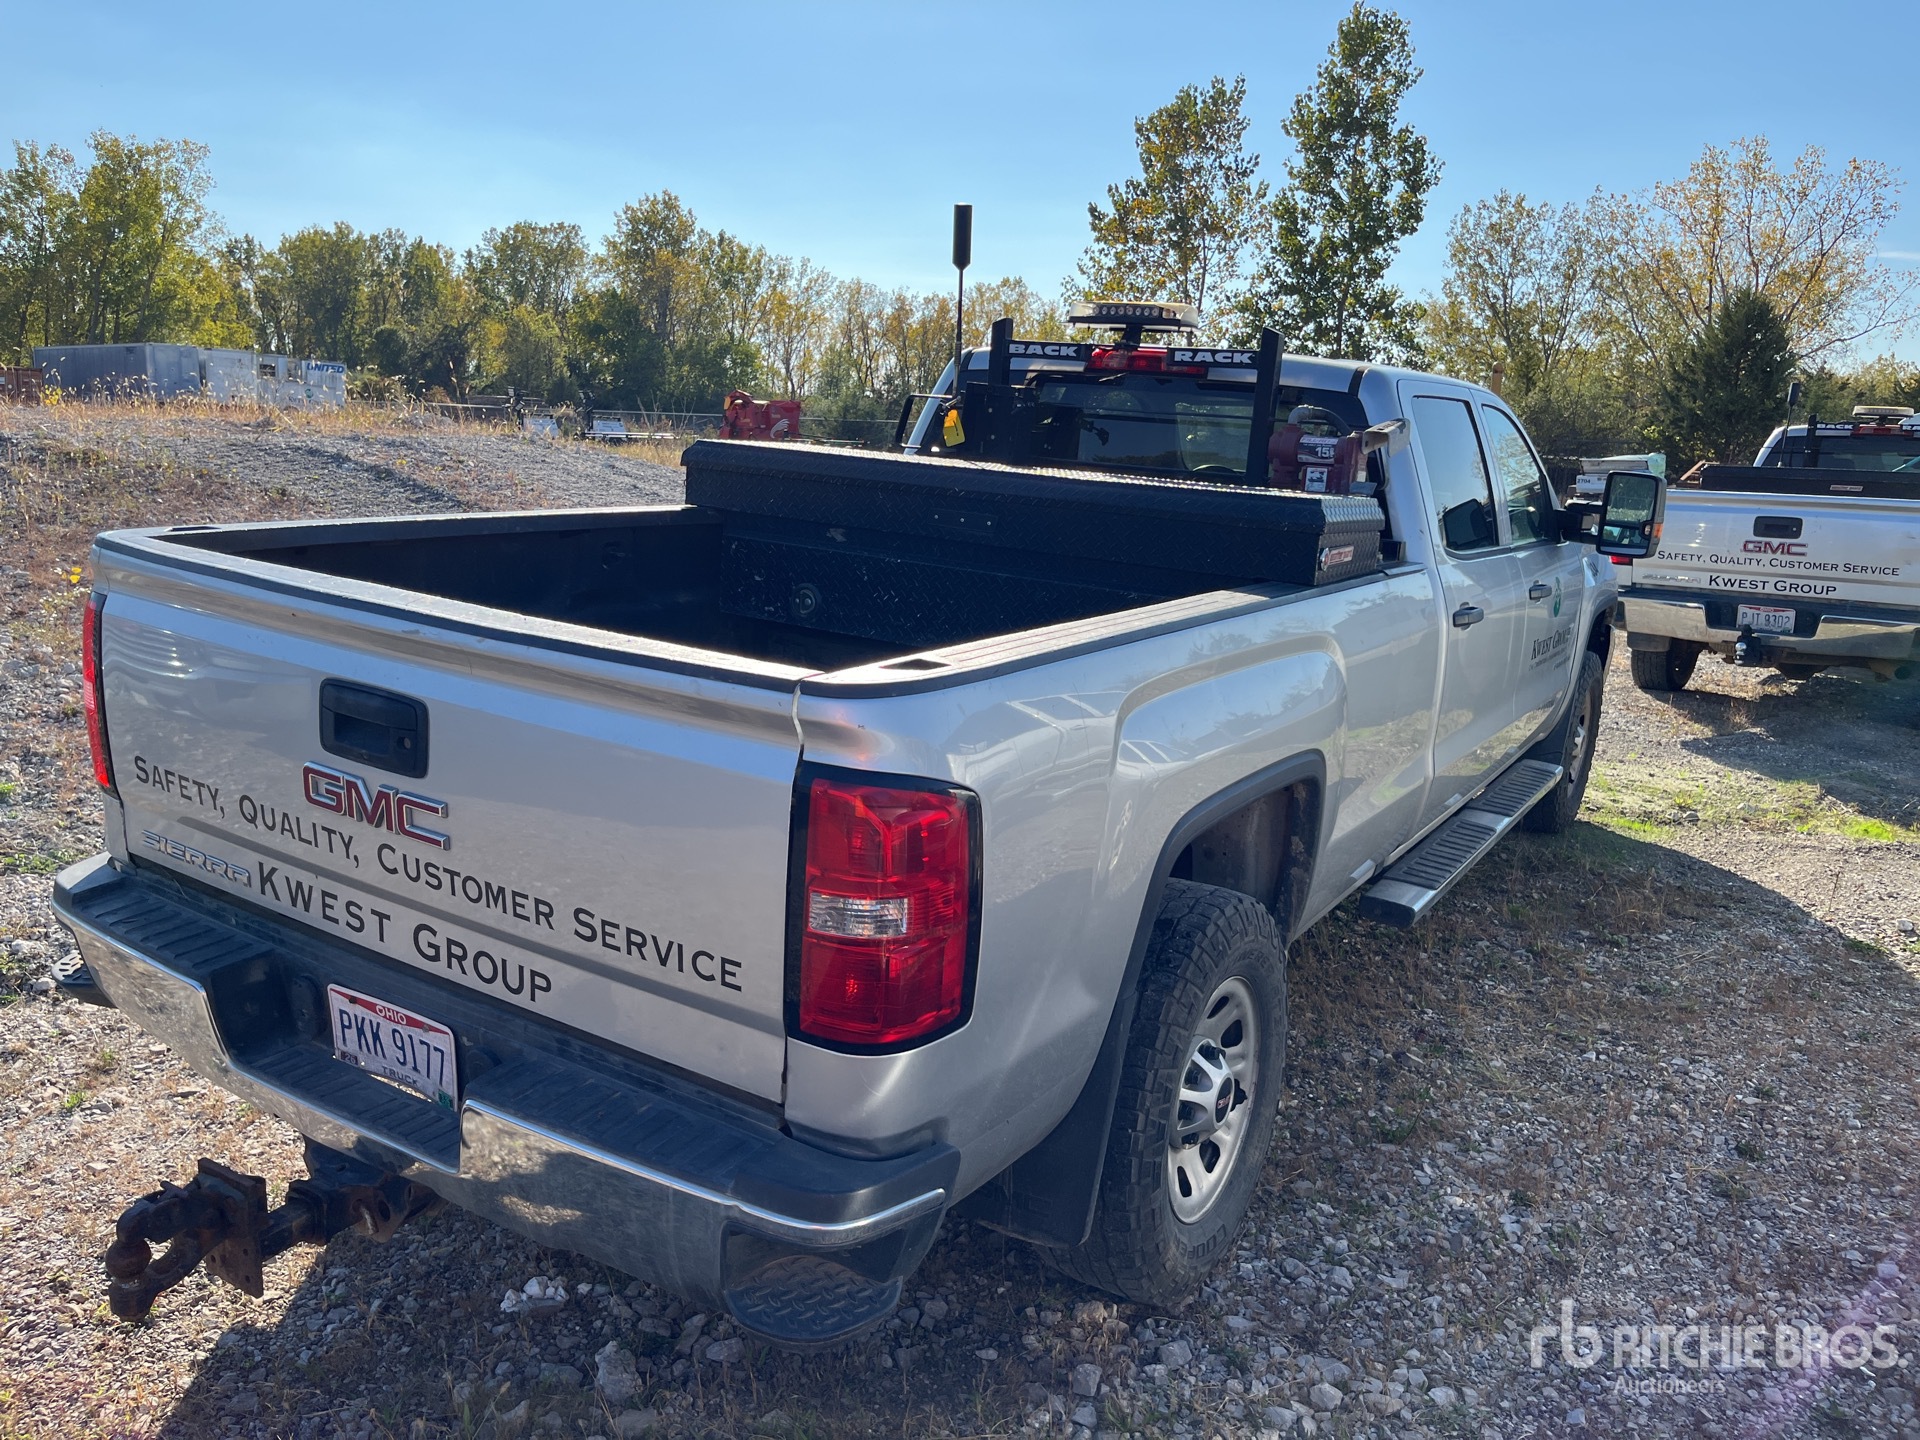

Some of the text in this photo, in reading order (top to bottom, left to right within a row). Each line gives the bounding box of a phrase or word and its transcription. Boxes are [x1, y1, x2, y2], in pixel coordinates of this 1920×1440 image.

[1008, 343, 1253, 364] BACK RACK
[307, 363, 345, 373] UNITED
[1743, 540, 1808, 556] GMC
[1657, 550, 1900, 576] SAFETY, QUALITY, CUSTOMER SERVICE
[1708, 575, 1838, 596] KWEST GROUP
[302, 760, 451, 851] GMC
[141, 829, 252, 889] SIERRA
[134, 755, 743, 993] SAFETY, QUALITY, CUSTOMER SERVICE
[258, 860, 553, 1002] KWEST GROUP
[375, 1004, 407, 1025] OHIO
[338, 1008, 445, 1087] PKK 9177
[381, 1065, 419, 1087] TRUCK
